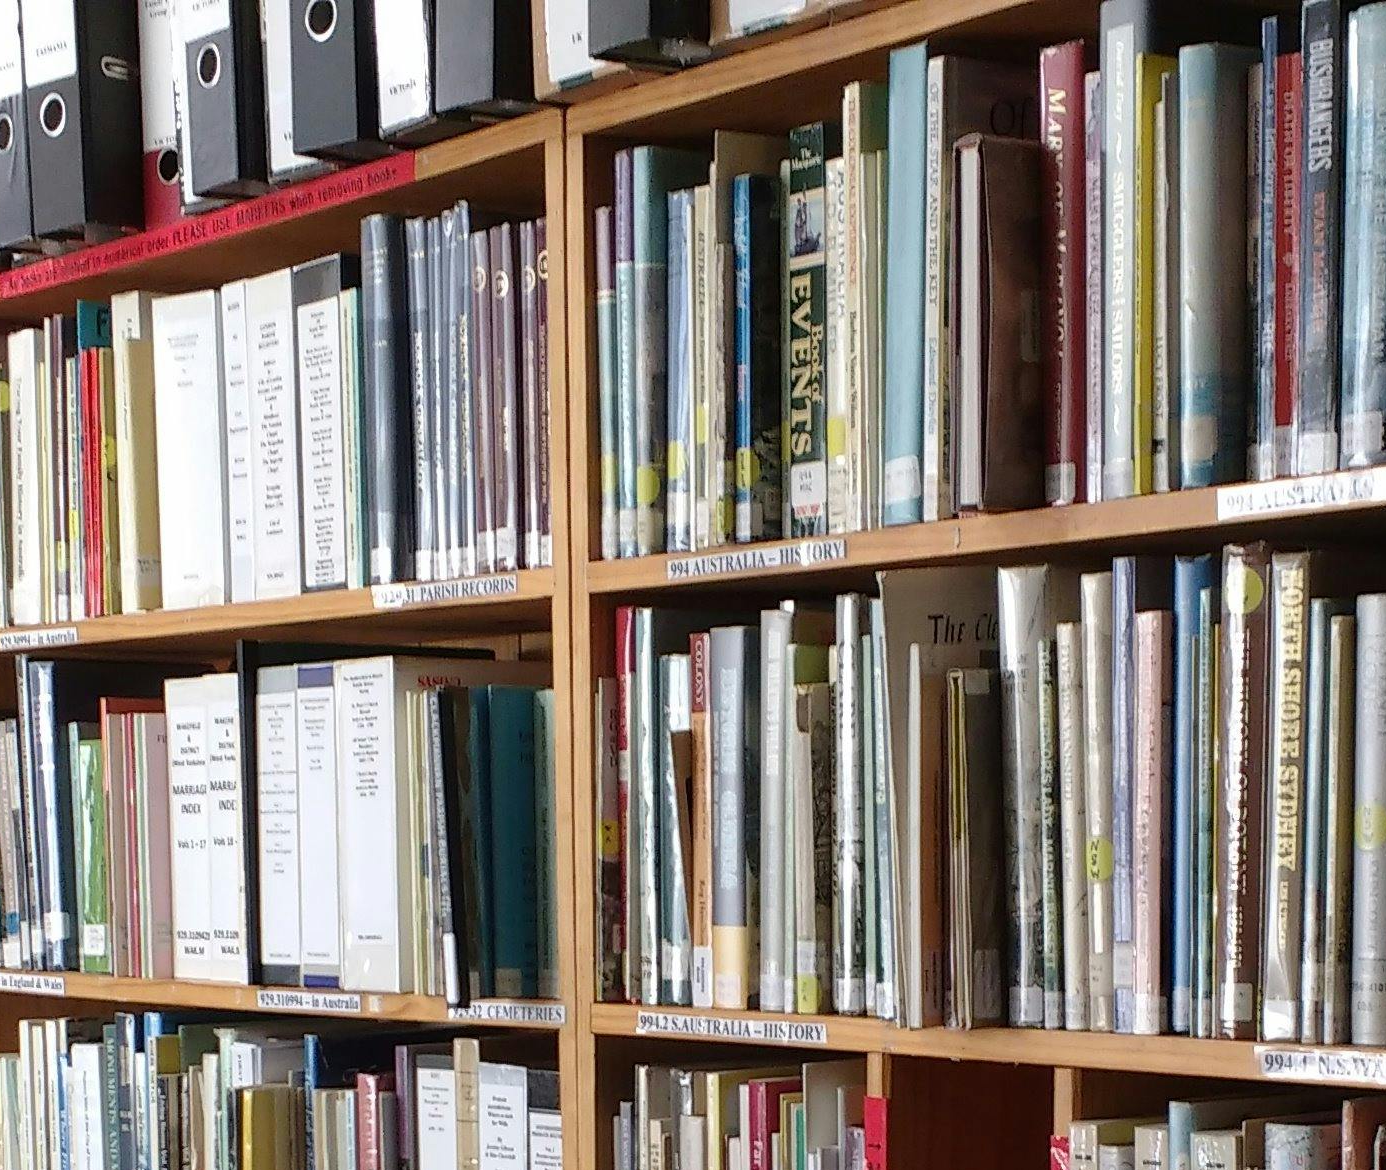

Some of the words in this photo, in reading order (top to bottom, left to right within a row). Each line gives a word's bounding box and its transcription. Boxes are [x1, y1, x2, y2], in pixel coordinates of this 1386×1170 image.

[1308, 38, 1334, 172] BUSHRANGERS
[1112, 172, 1126, 294] SMUGGLERS
[791, 272, 812, 456] EVENTS
[810, 325, 824, 372] Book
[1111, 310, 1124, 395] SAILORS
[670, 561, 689, 577] 994
[692, 551, 766, 575] AUSTRALIA
[420, 583, 459, 602] PARISH
[461, 575, 514, 598] RECORDS
[928, 614, 967, 643] The
[1280, 568, 1304, 666] NORTH
[695, 640, 704, 704] COLONY
[180, 802, 201, 815] INDEX
[1276, 764, 1298, 872] SYDNEY
[321, 995, 359, 1010] Australia
[487, 1005, 562, 1022] CEMETERIES
[639, 1015, 669, 1031] 994.2
[671, 1017, 751, 1037] S.AUSTRALIA
[763, 1023, 824, 1041] HISTORY
[106, 1036, 117, 1123] MONUMENTS
[753, 1140, 766, 1167] Far
